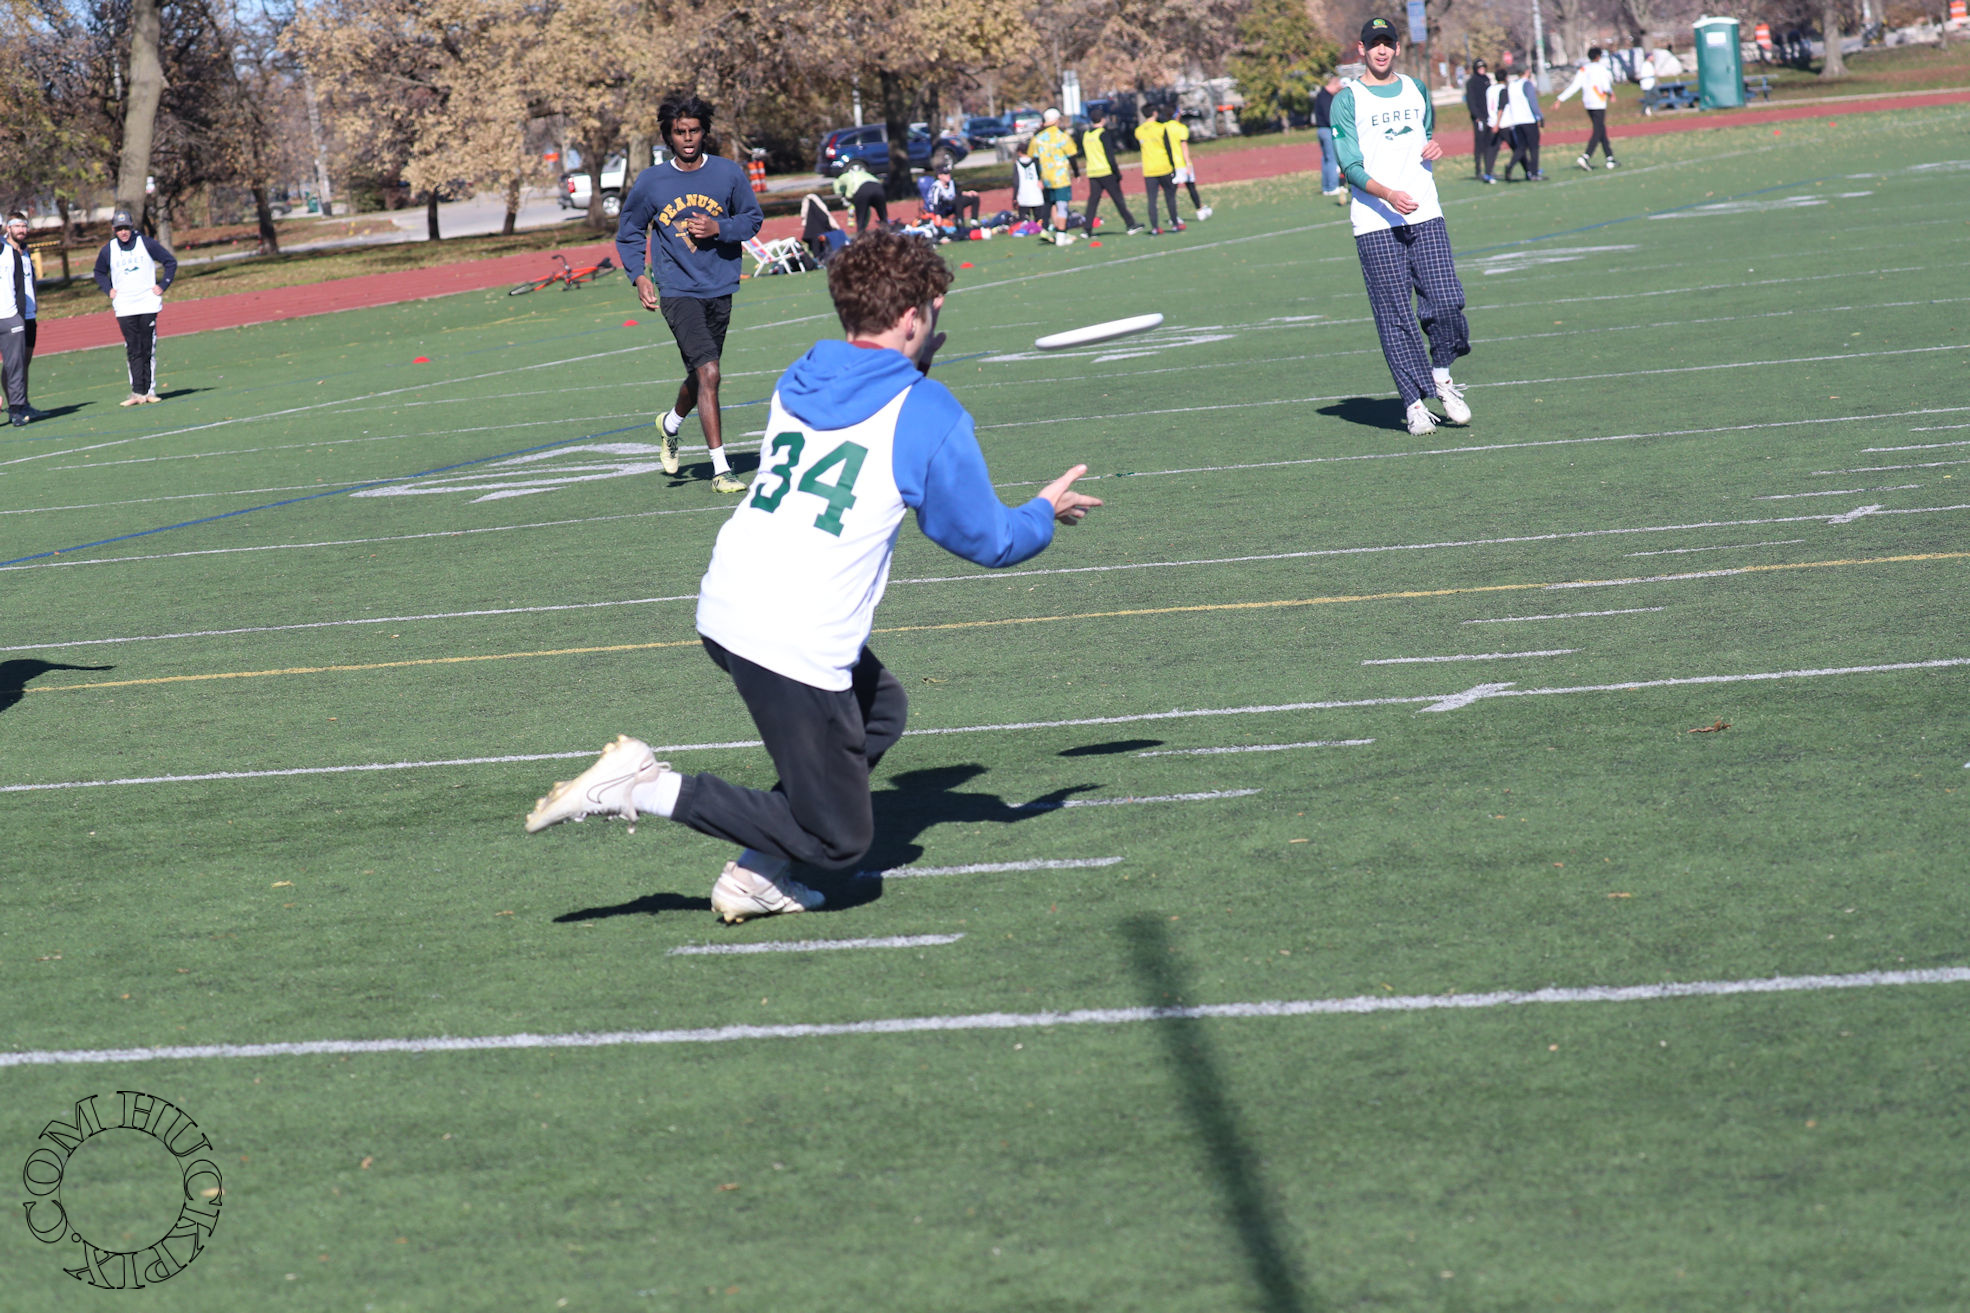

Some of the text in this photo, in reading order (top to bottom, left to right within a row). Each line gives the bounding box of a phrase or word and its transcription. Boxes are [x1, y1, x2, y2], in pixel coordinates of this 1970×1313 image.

[1371, 109, 1420, 127] EGRET
[658, 193, 724, 227] PEANUTS
[750, 431, 869, 538] 34
